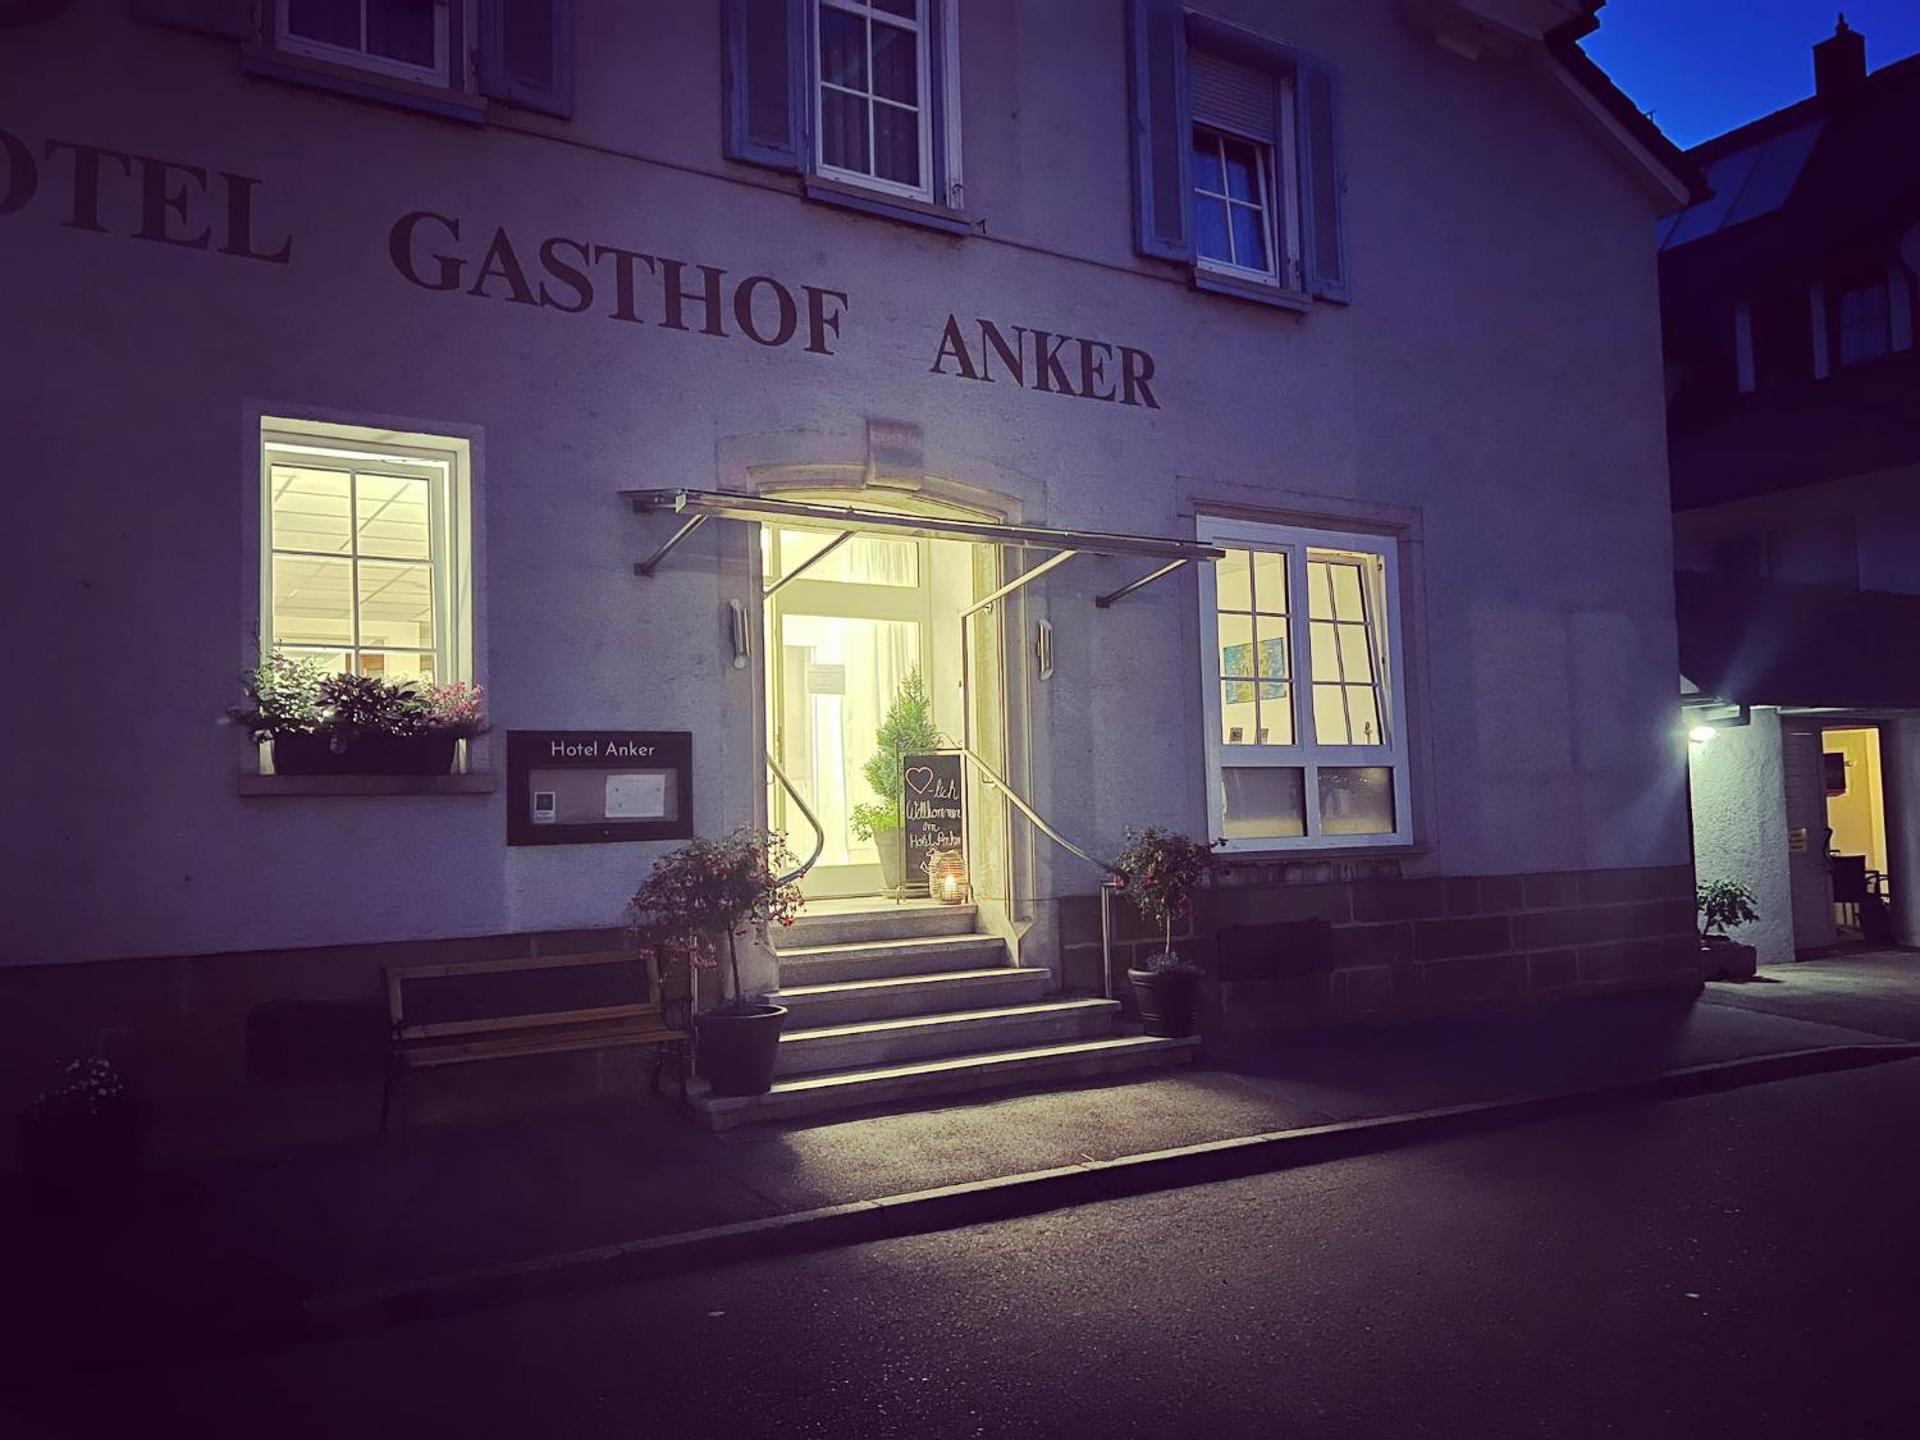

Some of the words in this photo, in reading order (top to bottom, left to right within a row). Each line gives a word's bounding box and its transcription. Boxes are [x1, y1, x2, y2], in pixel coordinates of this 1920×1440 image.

[388, 209, 848, 356] GASTHOF
[928, 313, 1161, 410] ANKER
[551, 740, 598, 757] Hotel
[604, 740, 656, 757] Anker
